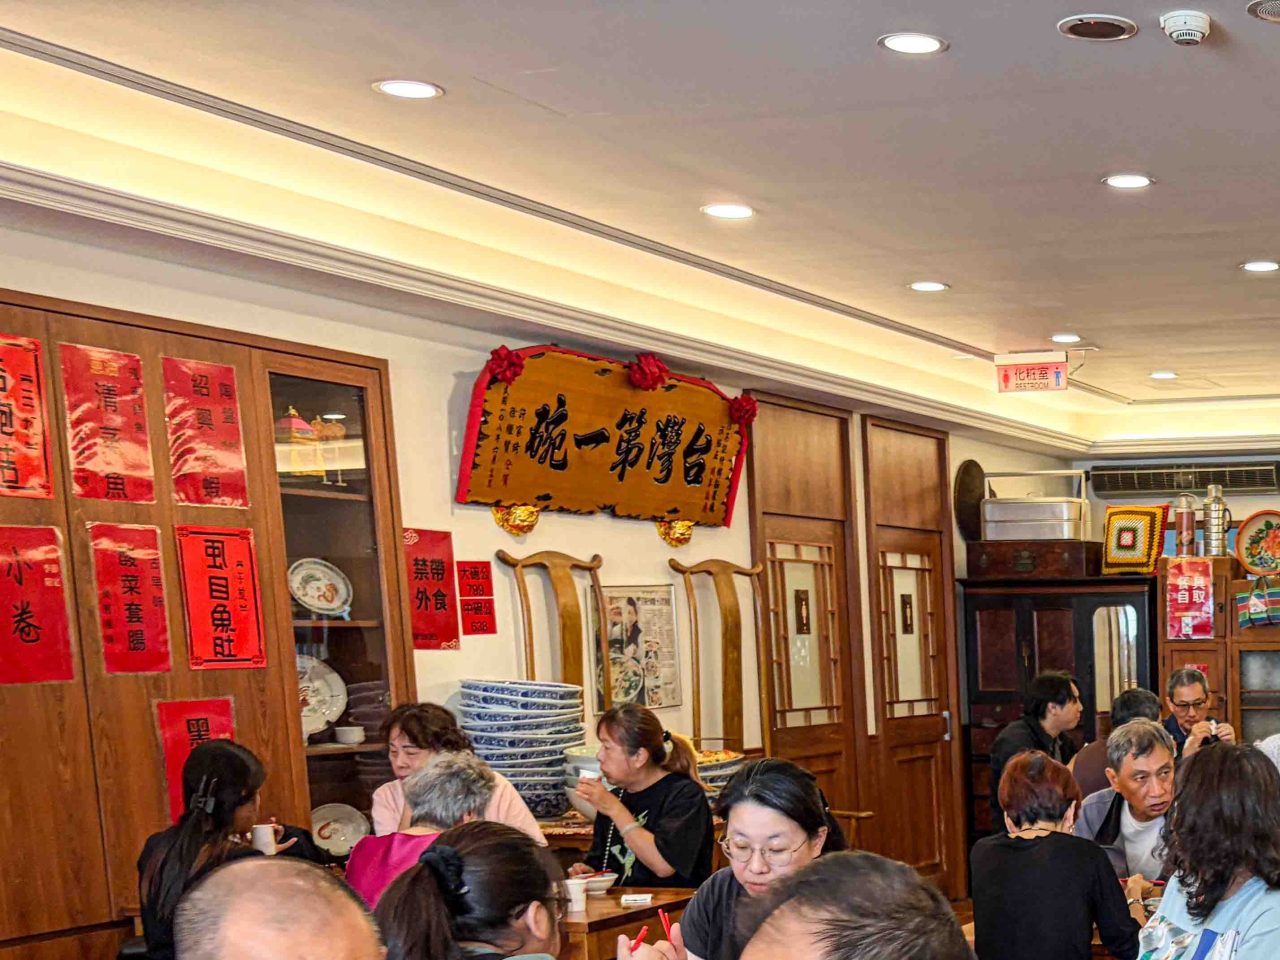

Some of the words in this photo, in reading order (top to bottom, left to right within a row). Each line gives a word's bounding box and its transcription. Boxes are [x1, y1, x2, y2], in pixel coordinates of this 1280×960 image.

[1014, 367, 1048, 381] 化粧室
[412, 557, 446, 581] 禁帶
[6, 546, 42, 644] 小卷
[203, 538, 237, 658] 虱目魚肚
[415, 588, 448, 612] 外食
[1178, 590, 1206, 603] 自取
